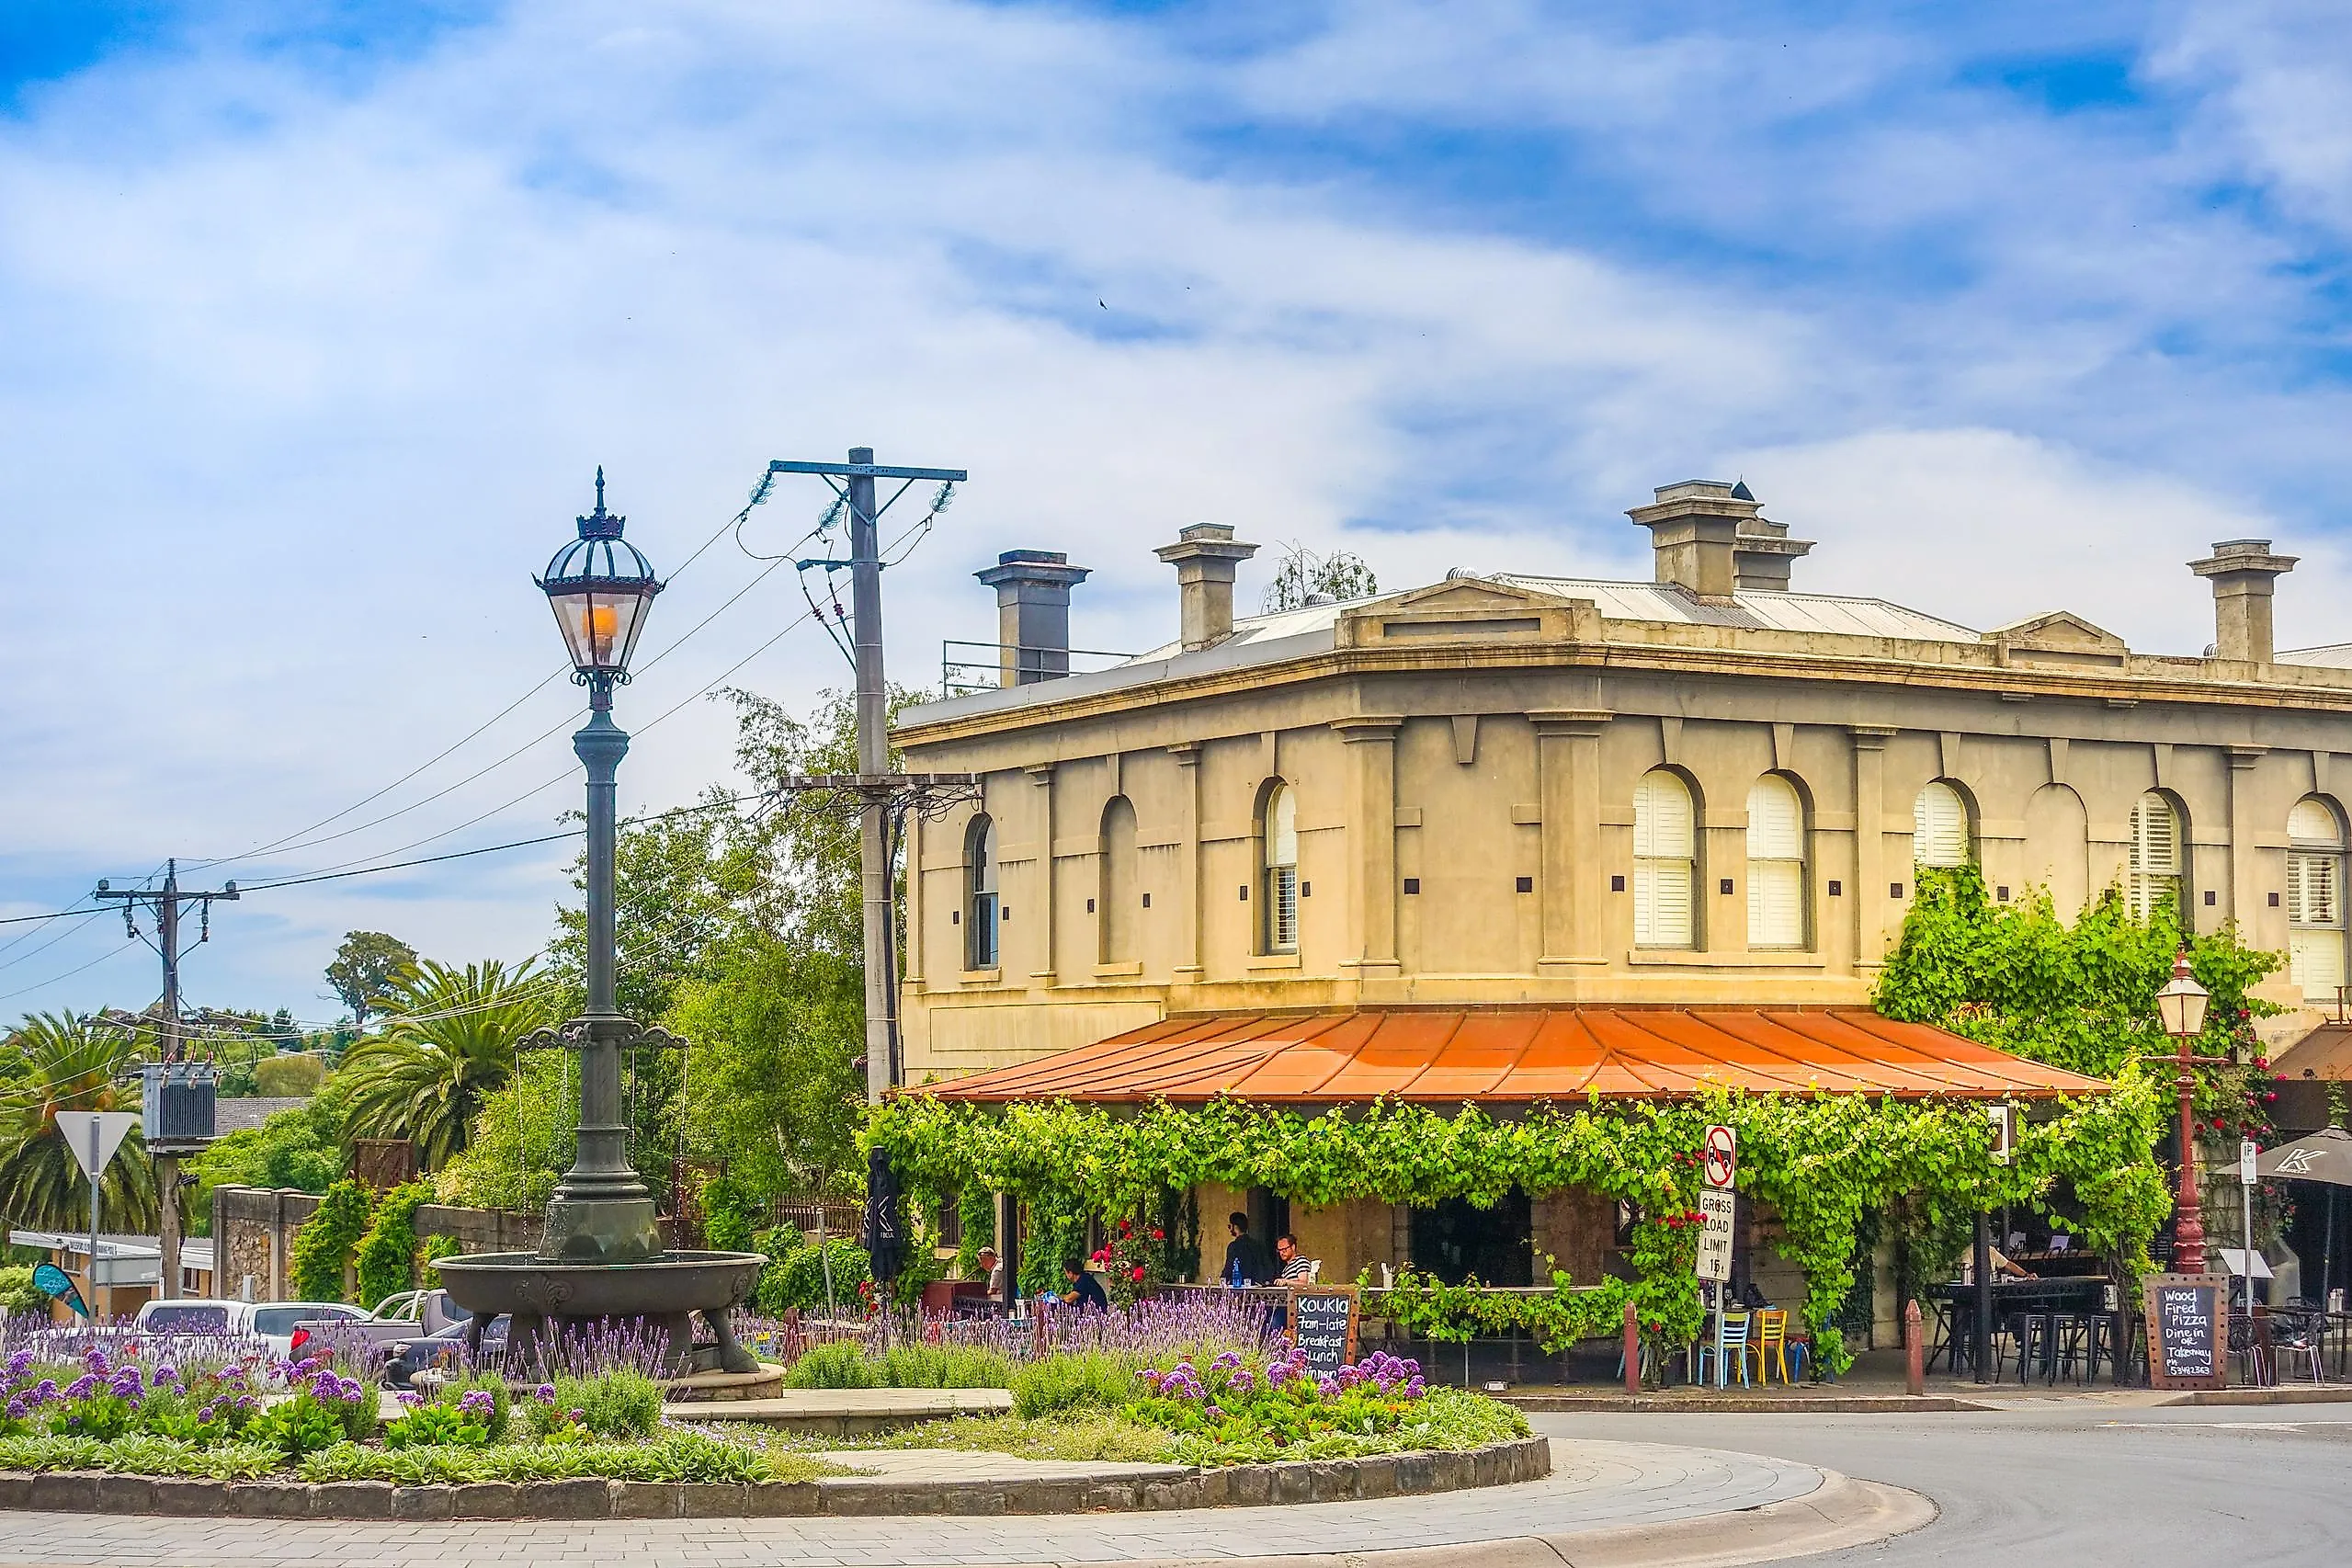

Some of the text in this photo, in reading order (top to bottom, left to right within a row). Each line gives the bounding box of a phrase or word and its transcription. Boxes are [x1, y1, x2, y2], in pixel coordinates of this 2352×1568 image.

[1702, 1197, 1732, 1213] GROSS
[1704, 1219, 1729, 1233] LOAD
[1703, 1237, 1728, 1254] LIMIT
[2165, 1288, 2197, 1301] Wood
[2165, 1301, 2197, 1315] Fired
[2172, 1314, 2208, 1327] Pizza
[1298, 1333, 1346, 1348] Breakfast
[1308, 1347, 1338, 1364] Lunch
[2166, 1346, 2211, 1366] Takeaway
